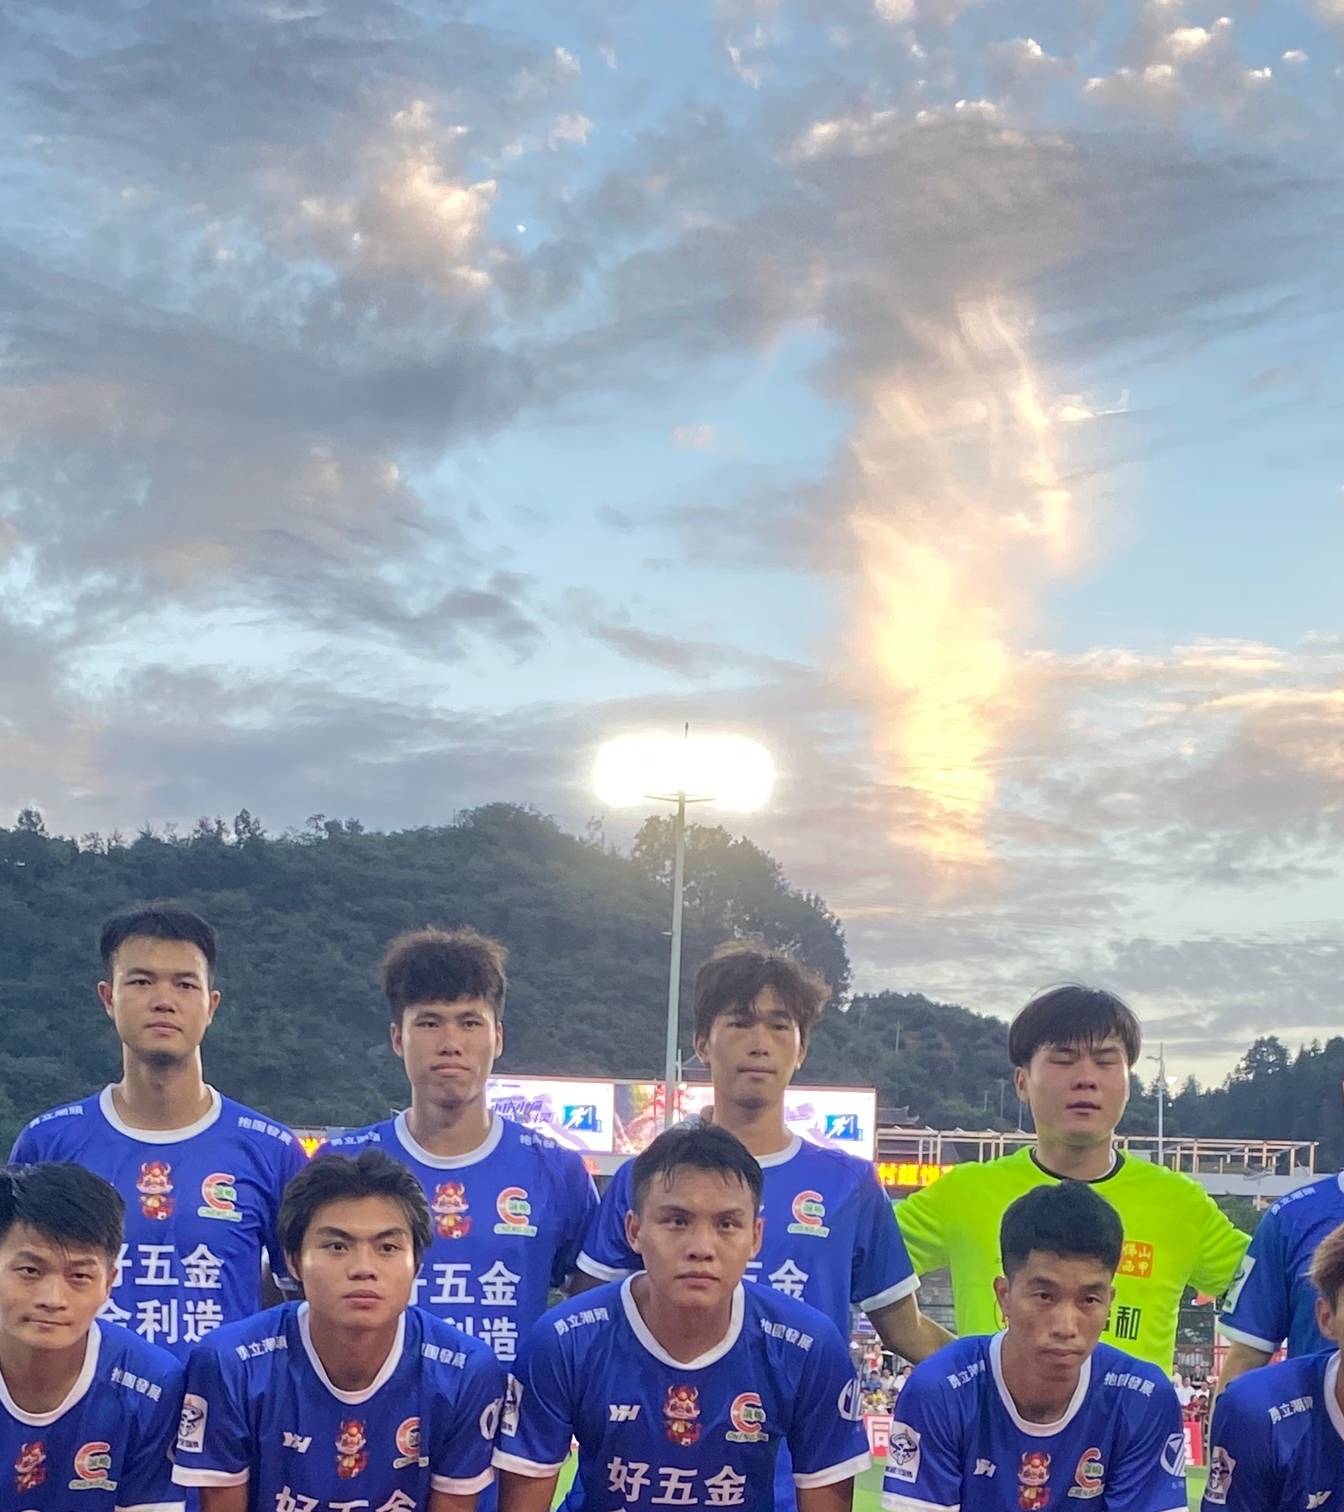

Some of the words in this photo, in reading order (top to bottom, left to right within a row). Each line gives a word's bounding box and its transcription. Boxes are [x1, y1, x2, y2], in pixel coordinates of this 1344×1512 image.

[408, 1260, 521, 1307] 五金
[607, 1456, 747, 1506] 好五金
